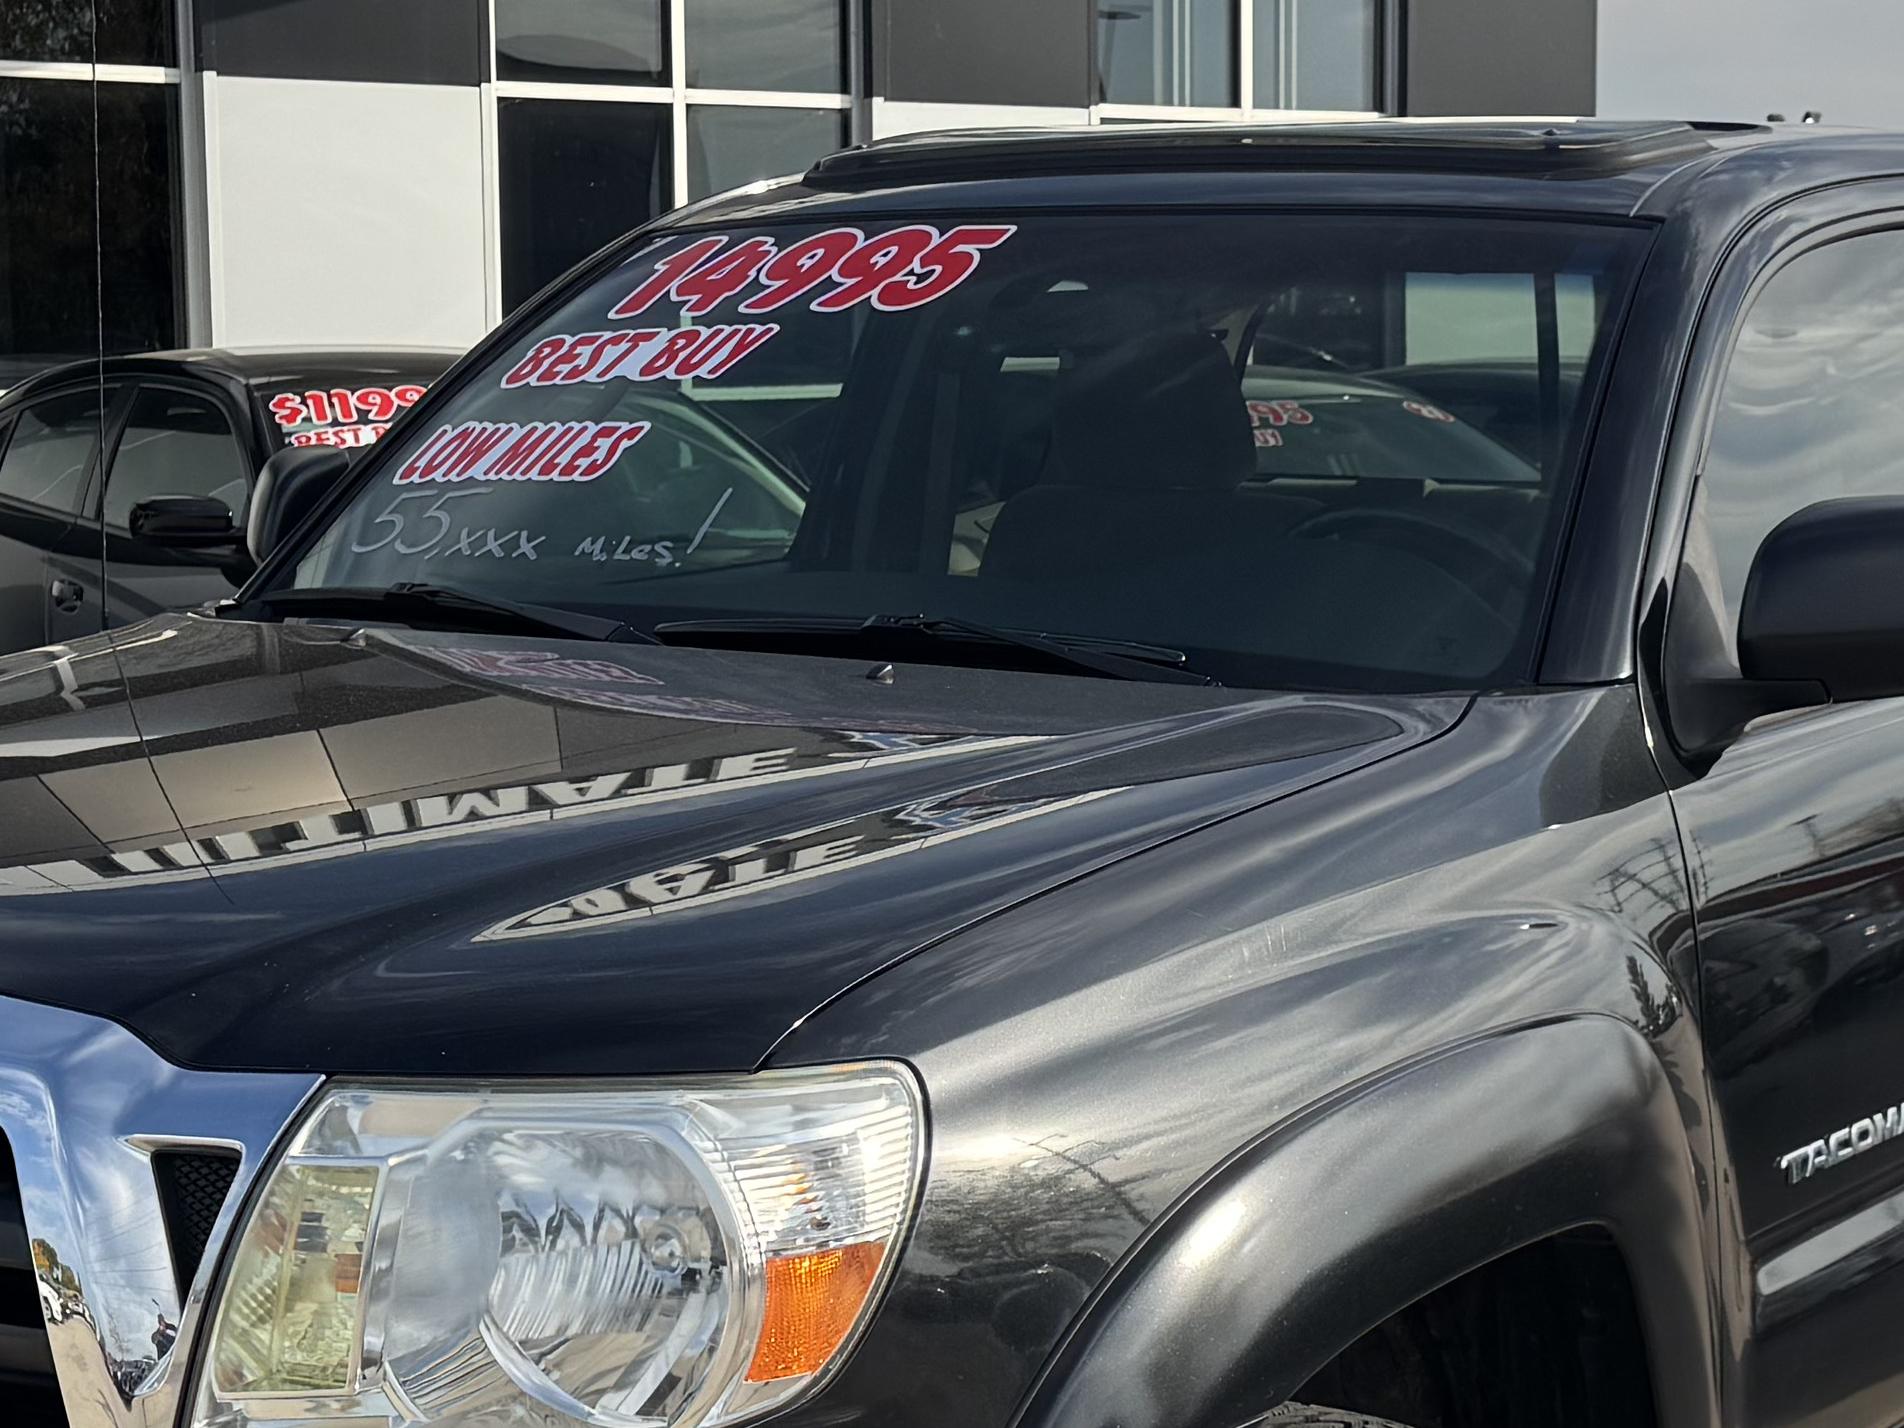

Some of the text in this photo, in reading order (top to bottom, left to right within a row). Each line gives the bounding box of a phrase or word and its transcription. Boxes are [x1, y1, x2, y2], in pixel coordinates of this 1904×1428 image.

[609, 224, 1017, 321] 14995
[501, 323, 780, 388] BEST BUY
[393, 422, 512, 484] LOW
[483, 421, 652, 483] MILES
